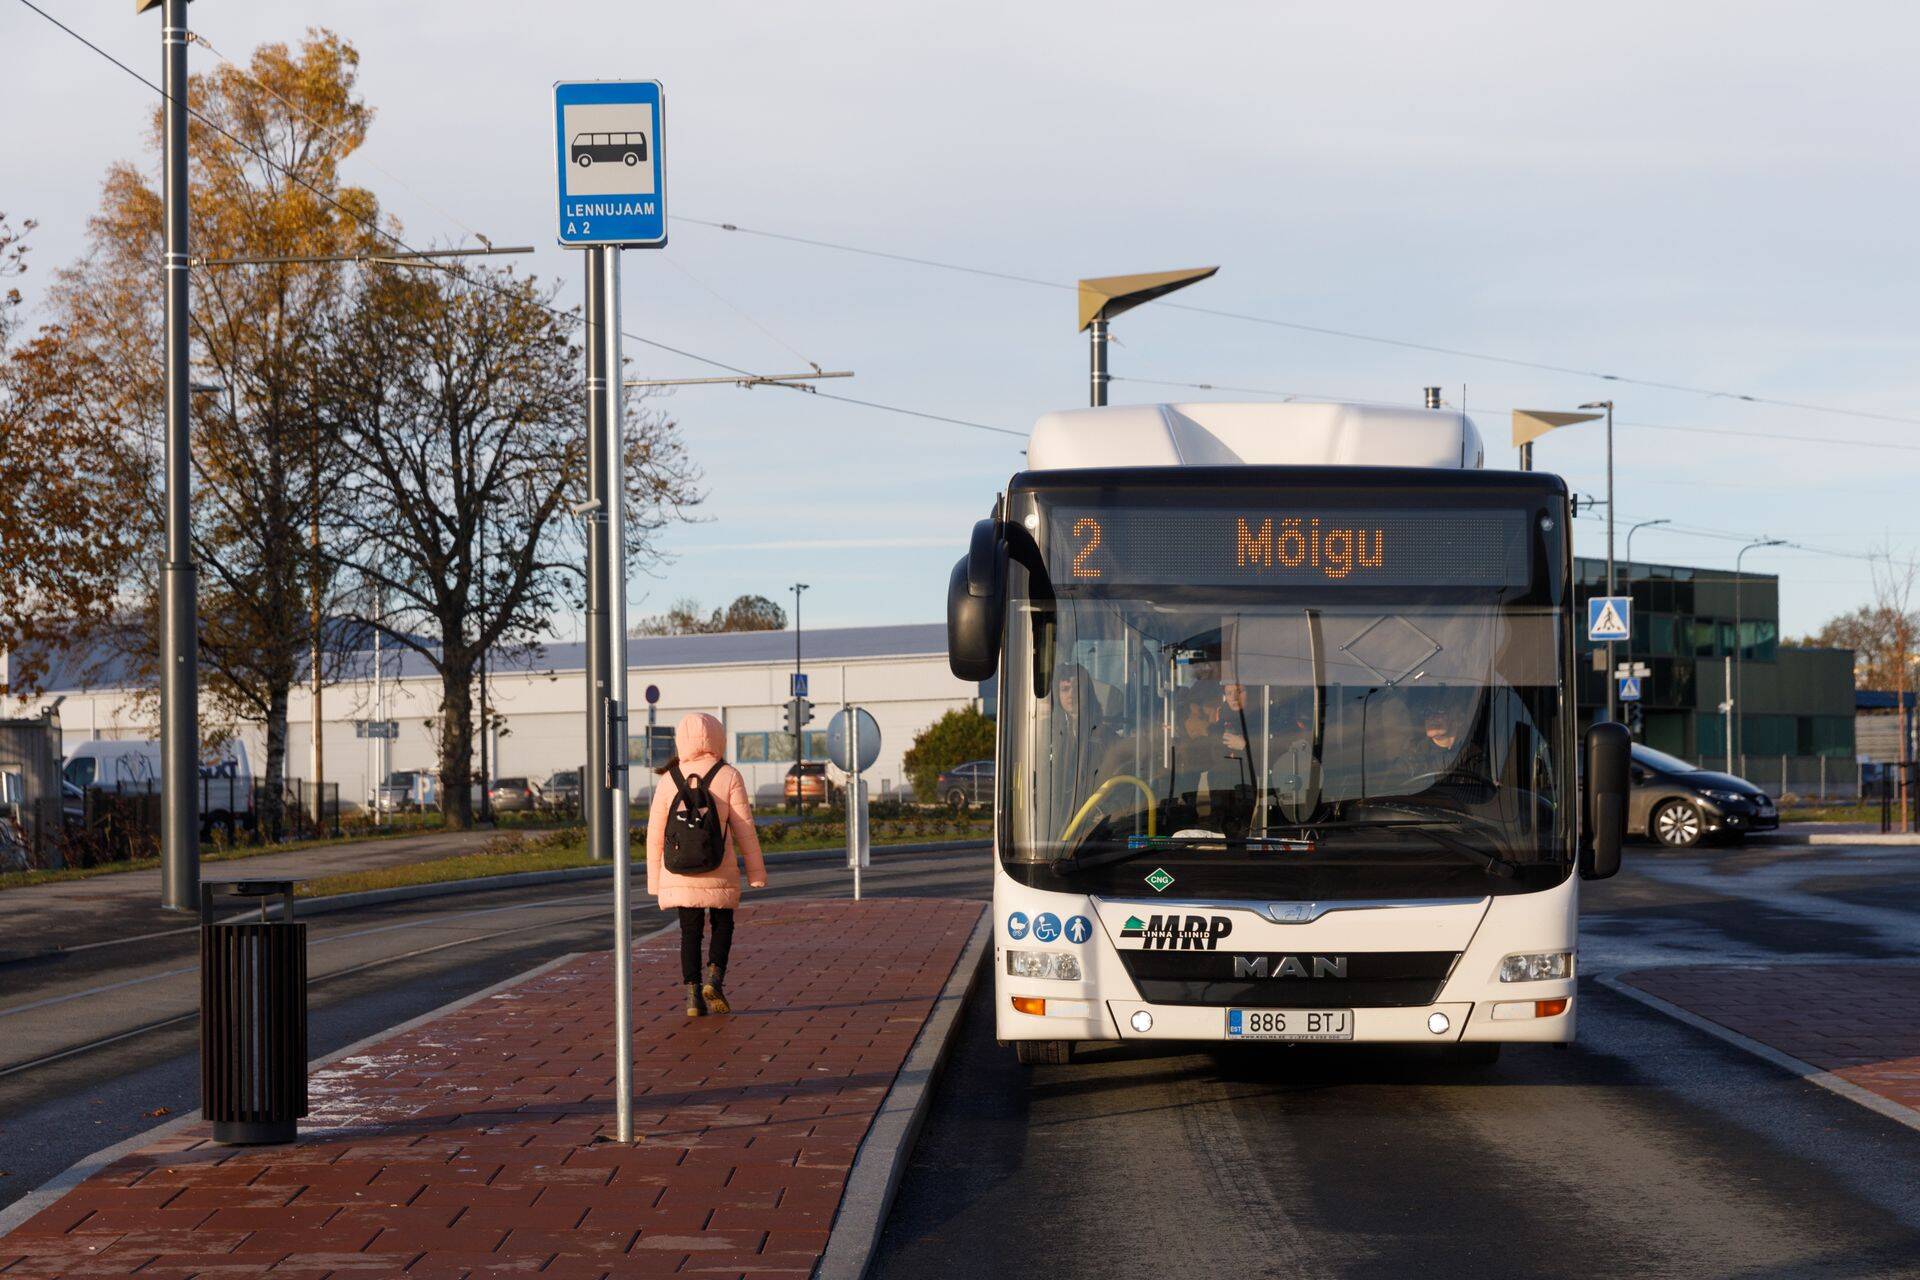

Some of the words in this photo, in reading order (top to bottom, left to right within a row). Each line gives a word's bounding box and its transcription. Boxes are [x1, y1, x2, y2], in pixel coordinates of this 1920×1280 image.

[567, 202, 655, 217] LENNUJAAM
[567, 222, 577, 234] A
[583, 222, 591, 234] 2
[1073, 517, 1102, 577] 2
[1237, 516, 1383, 578] Mõigu
[1150, 876, 1169, 884] CNG
[1142, 930, 1173, 938] LINNA
[1179, 930, 1210, 938] LIINID
[1143, 915, 1233, 950] MRP
[1233, 956, 1348, 978] MAN
[1230, 1025, 1242, 1033] EST
[1250, 1013, 1286, 1032] 886
[1307, 1013, 1345, 1032] BTJ
